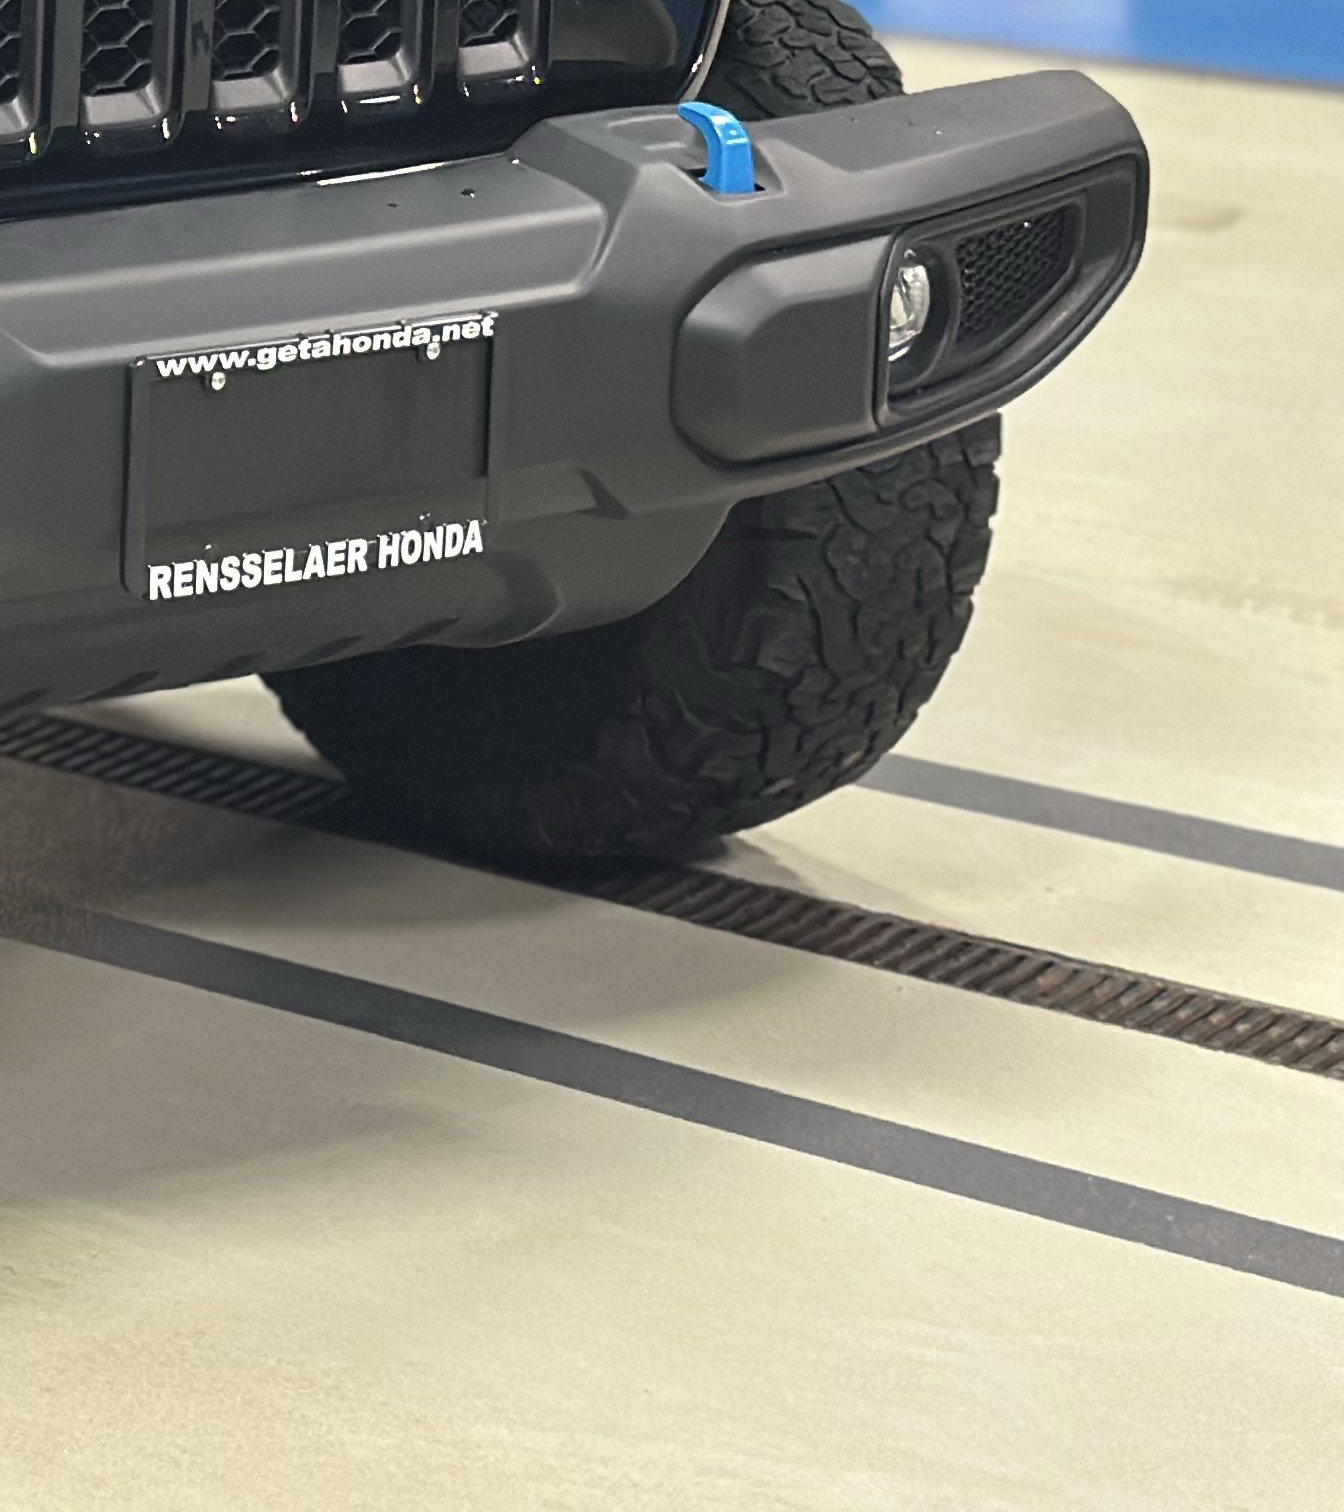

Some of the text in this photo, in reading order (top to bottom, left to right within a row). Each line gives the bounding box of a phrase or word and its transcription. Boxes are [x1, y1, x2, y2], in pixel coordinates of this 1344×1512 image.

[156, 315, 495, 379] www.getahonda.net
[148, 519, 484, 601] RENSSELAER HONDA
